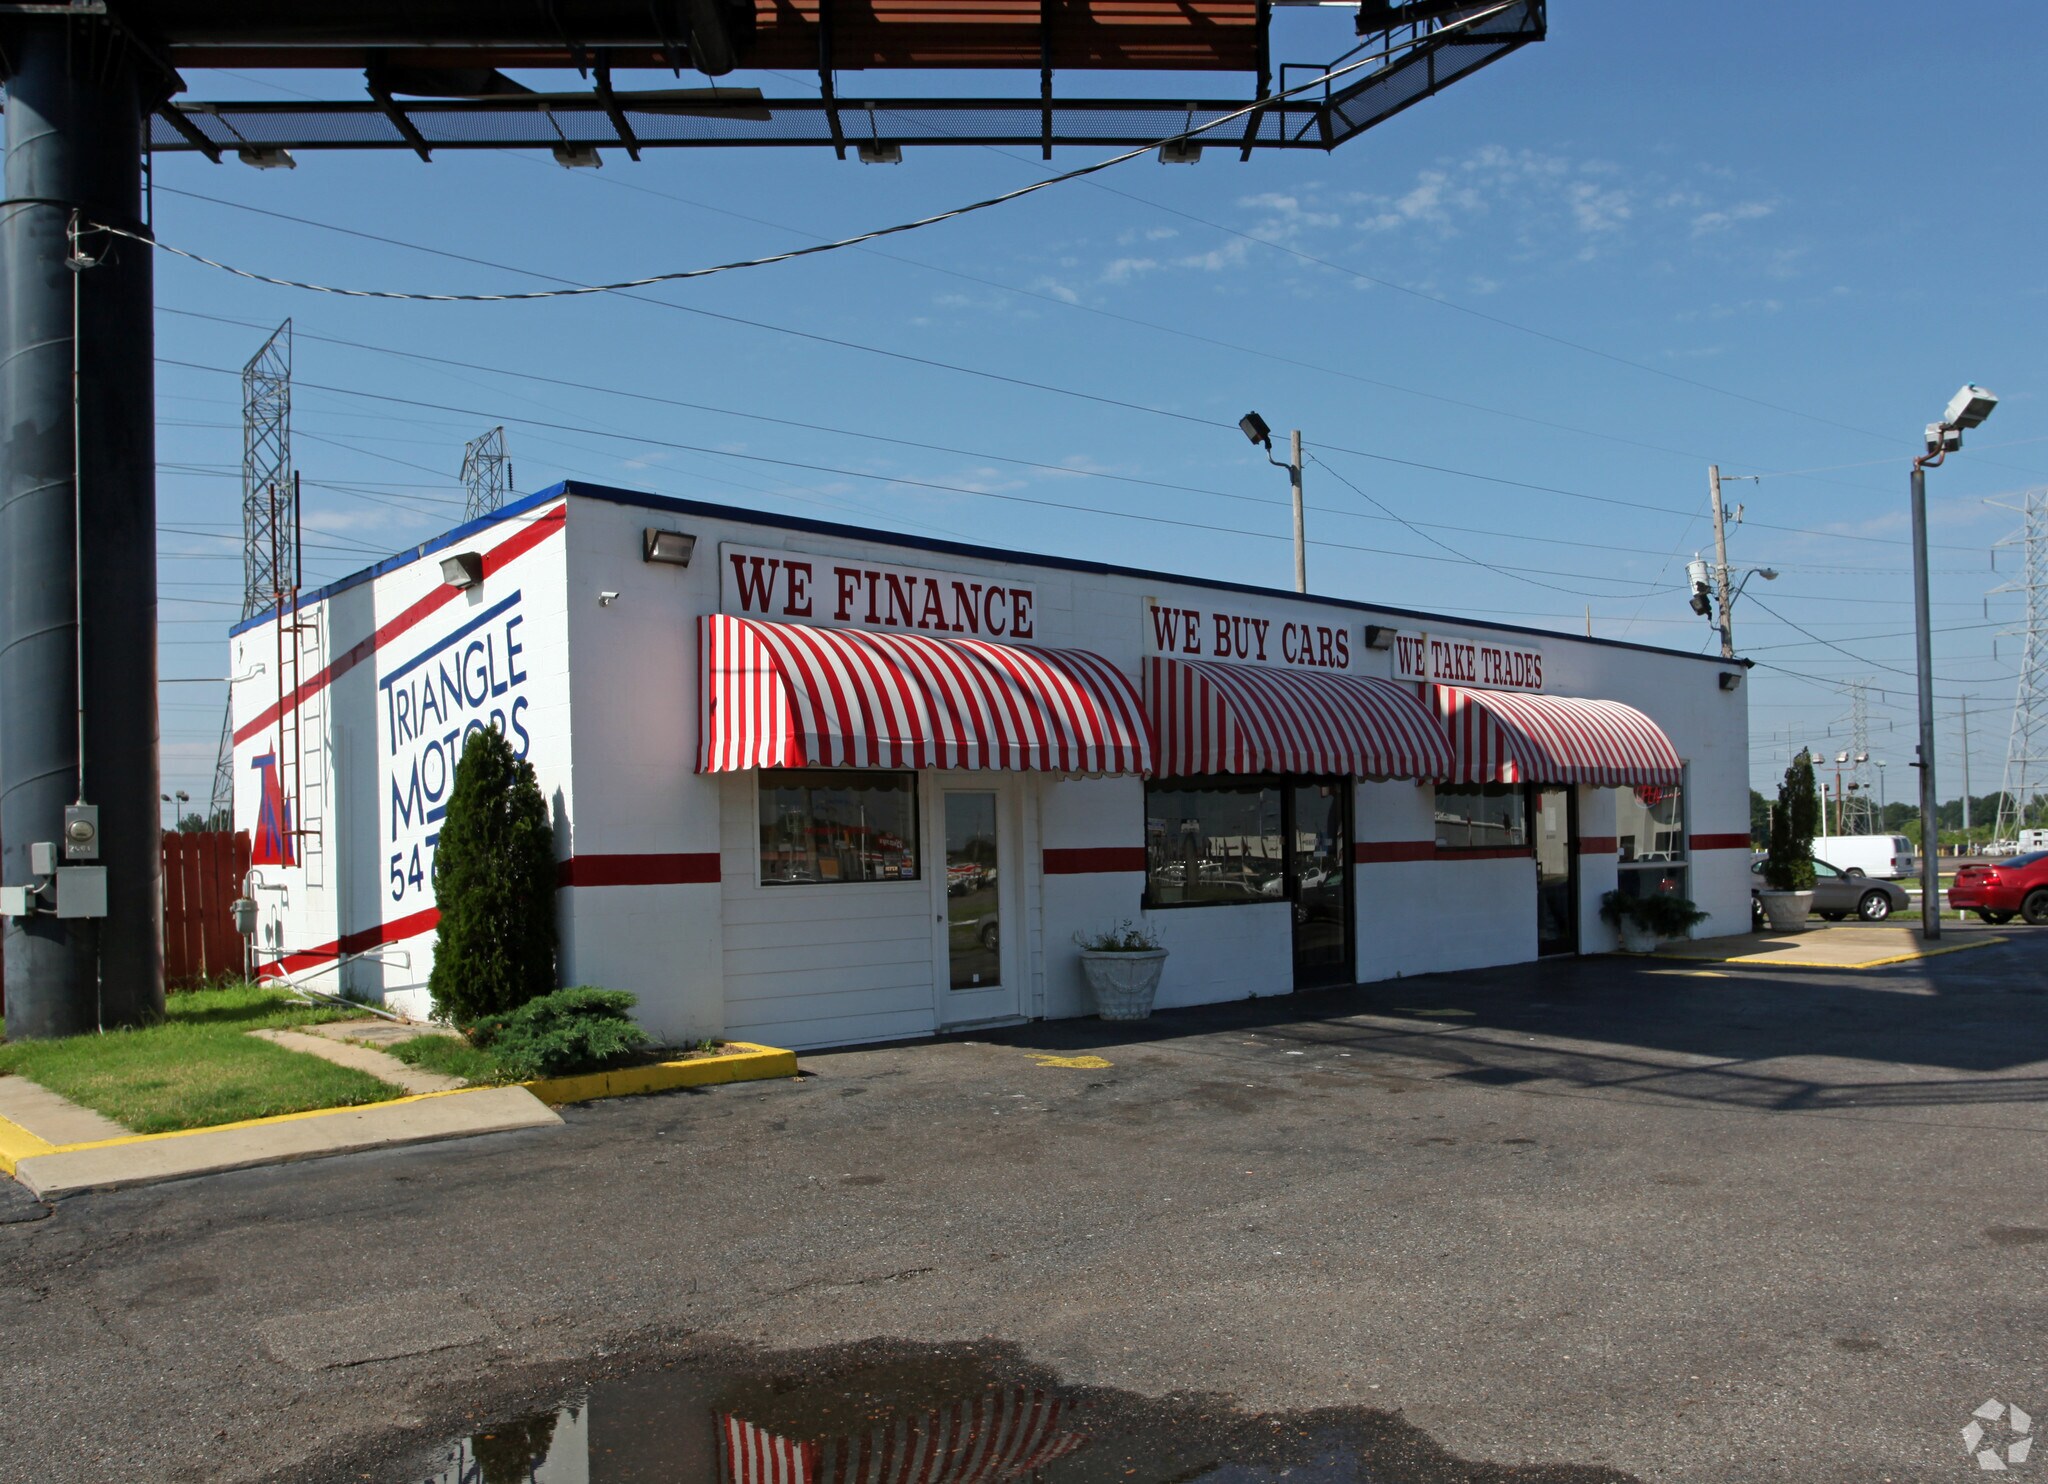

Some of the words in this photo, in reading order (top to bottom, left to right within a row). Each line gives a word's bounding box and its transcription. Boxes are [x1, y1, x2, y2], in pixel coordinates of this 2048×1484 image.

[730, 553, 812, 618] WE
[833, 566, 1034, 639] FINANCE
[379, 592, 528, 757] TRIANGLE
[1150, 605, 1201, 655] WE
[1212, 613, 1270, 662] BUY
[1281, 622, 1350, 670] CARS
[1396, 635, 1425, 676] WE
[1431, 640, 1476, 683] TAKE
[1481, 647, 1543, 690] TRADES
